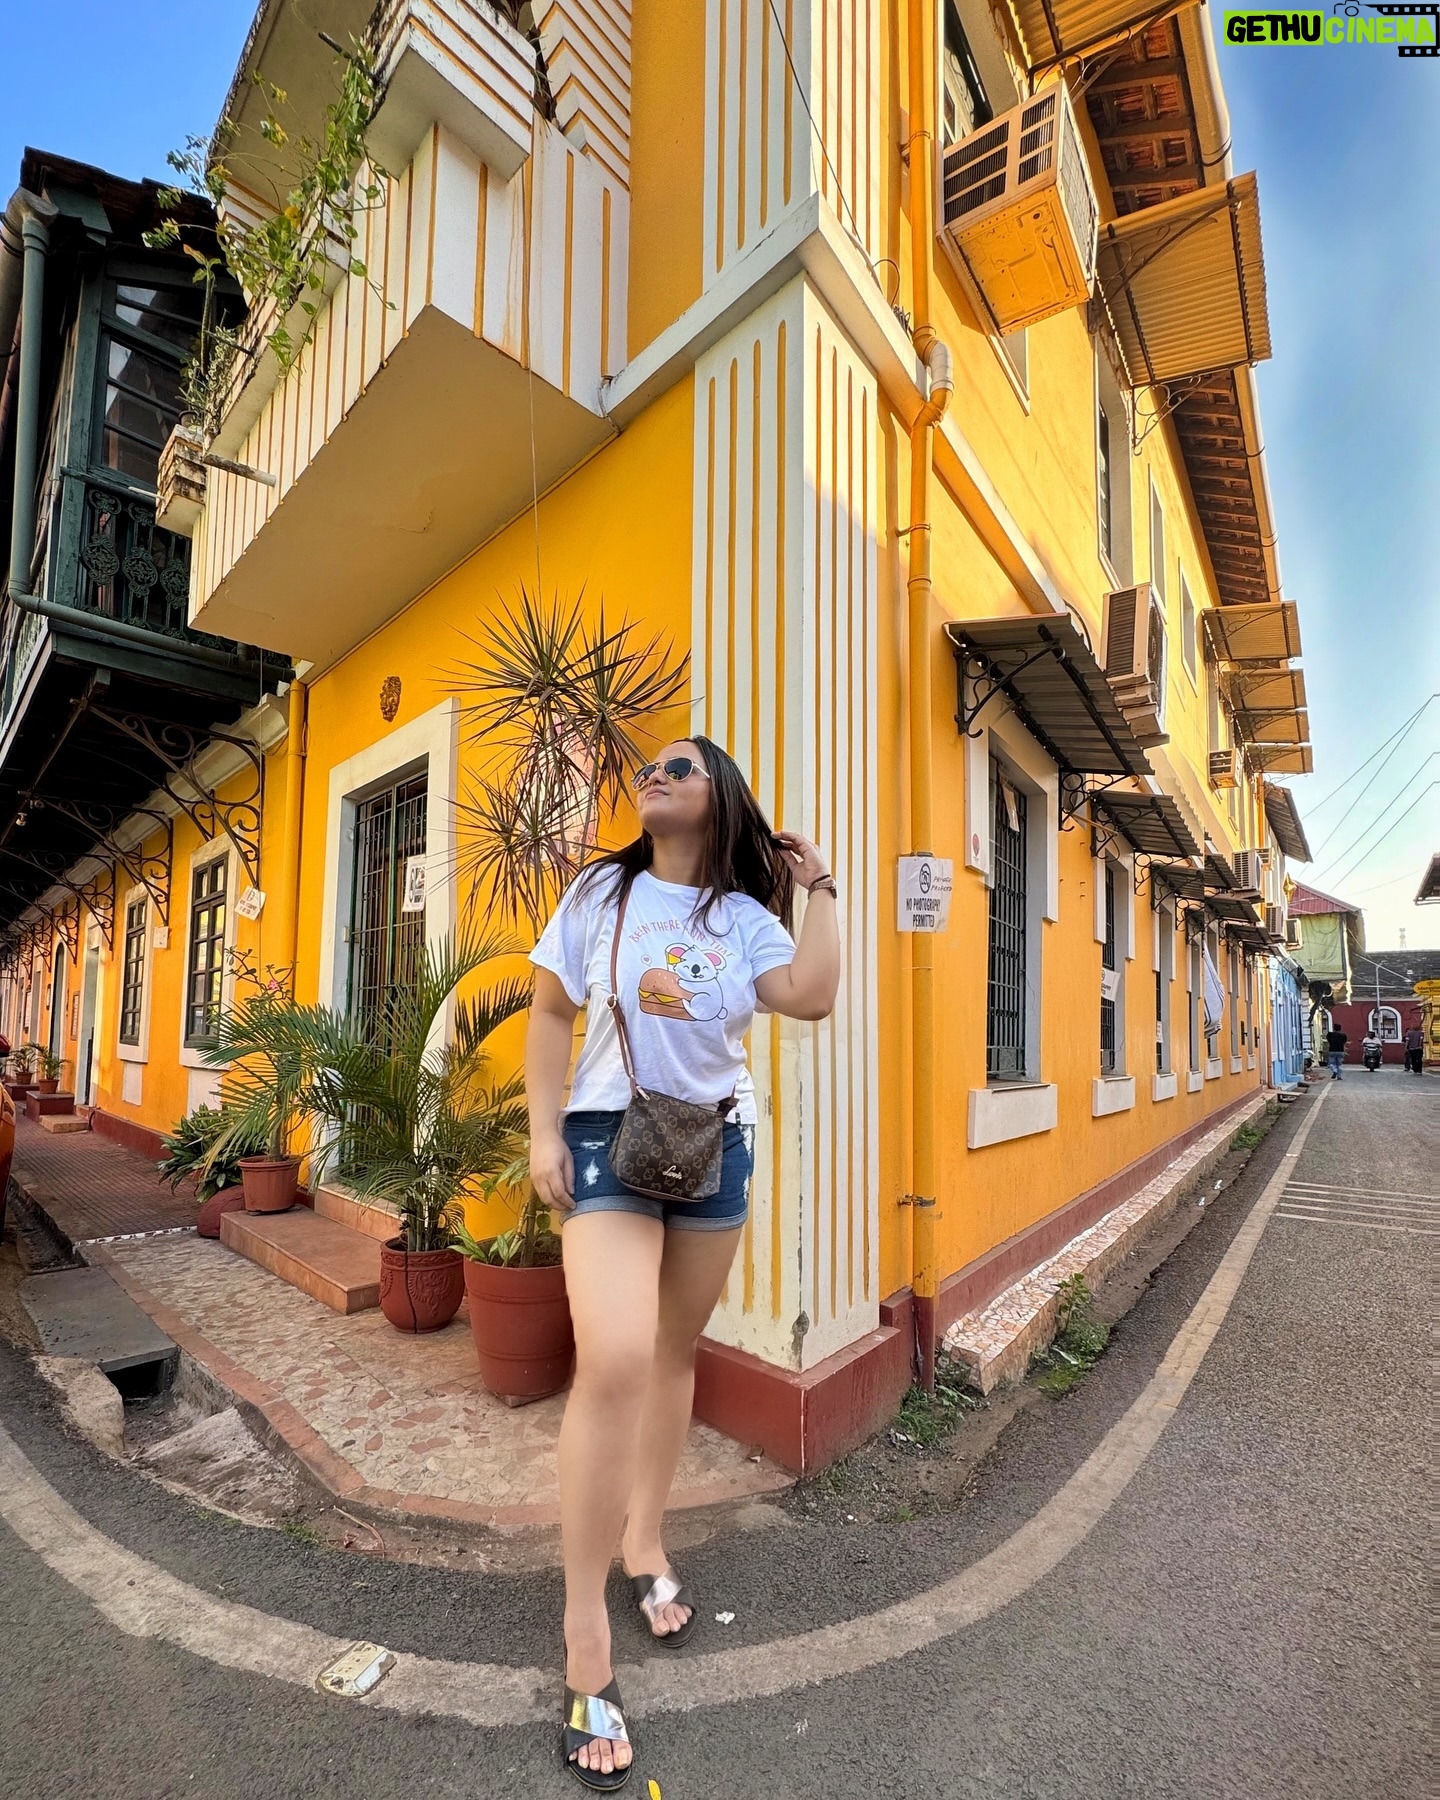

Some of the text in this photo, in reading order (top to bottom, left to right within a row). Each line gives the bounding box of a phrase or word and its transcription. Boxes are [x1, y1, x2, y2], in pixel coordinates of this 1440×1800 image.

[906, 898, 940, 911] NO PHOTOGRAPHY
[913, 914, 934, 927] PERMITTED
[629, 923, 651, 943] BEEN
[651, 920, 680, 931] THERE
[710, 939, 735, 957] THAT
